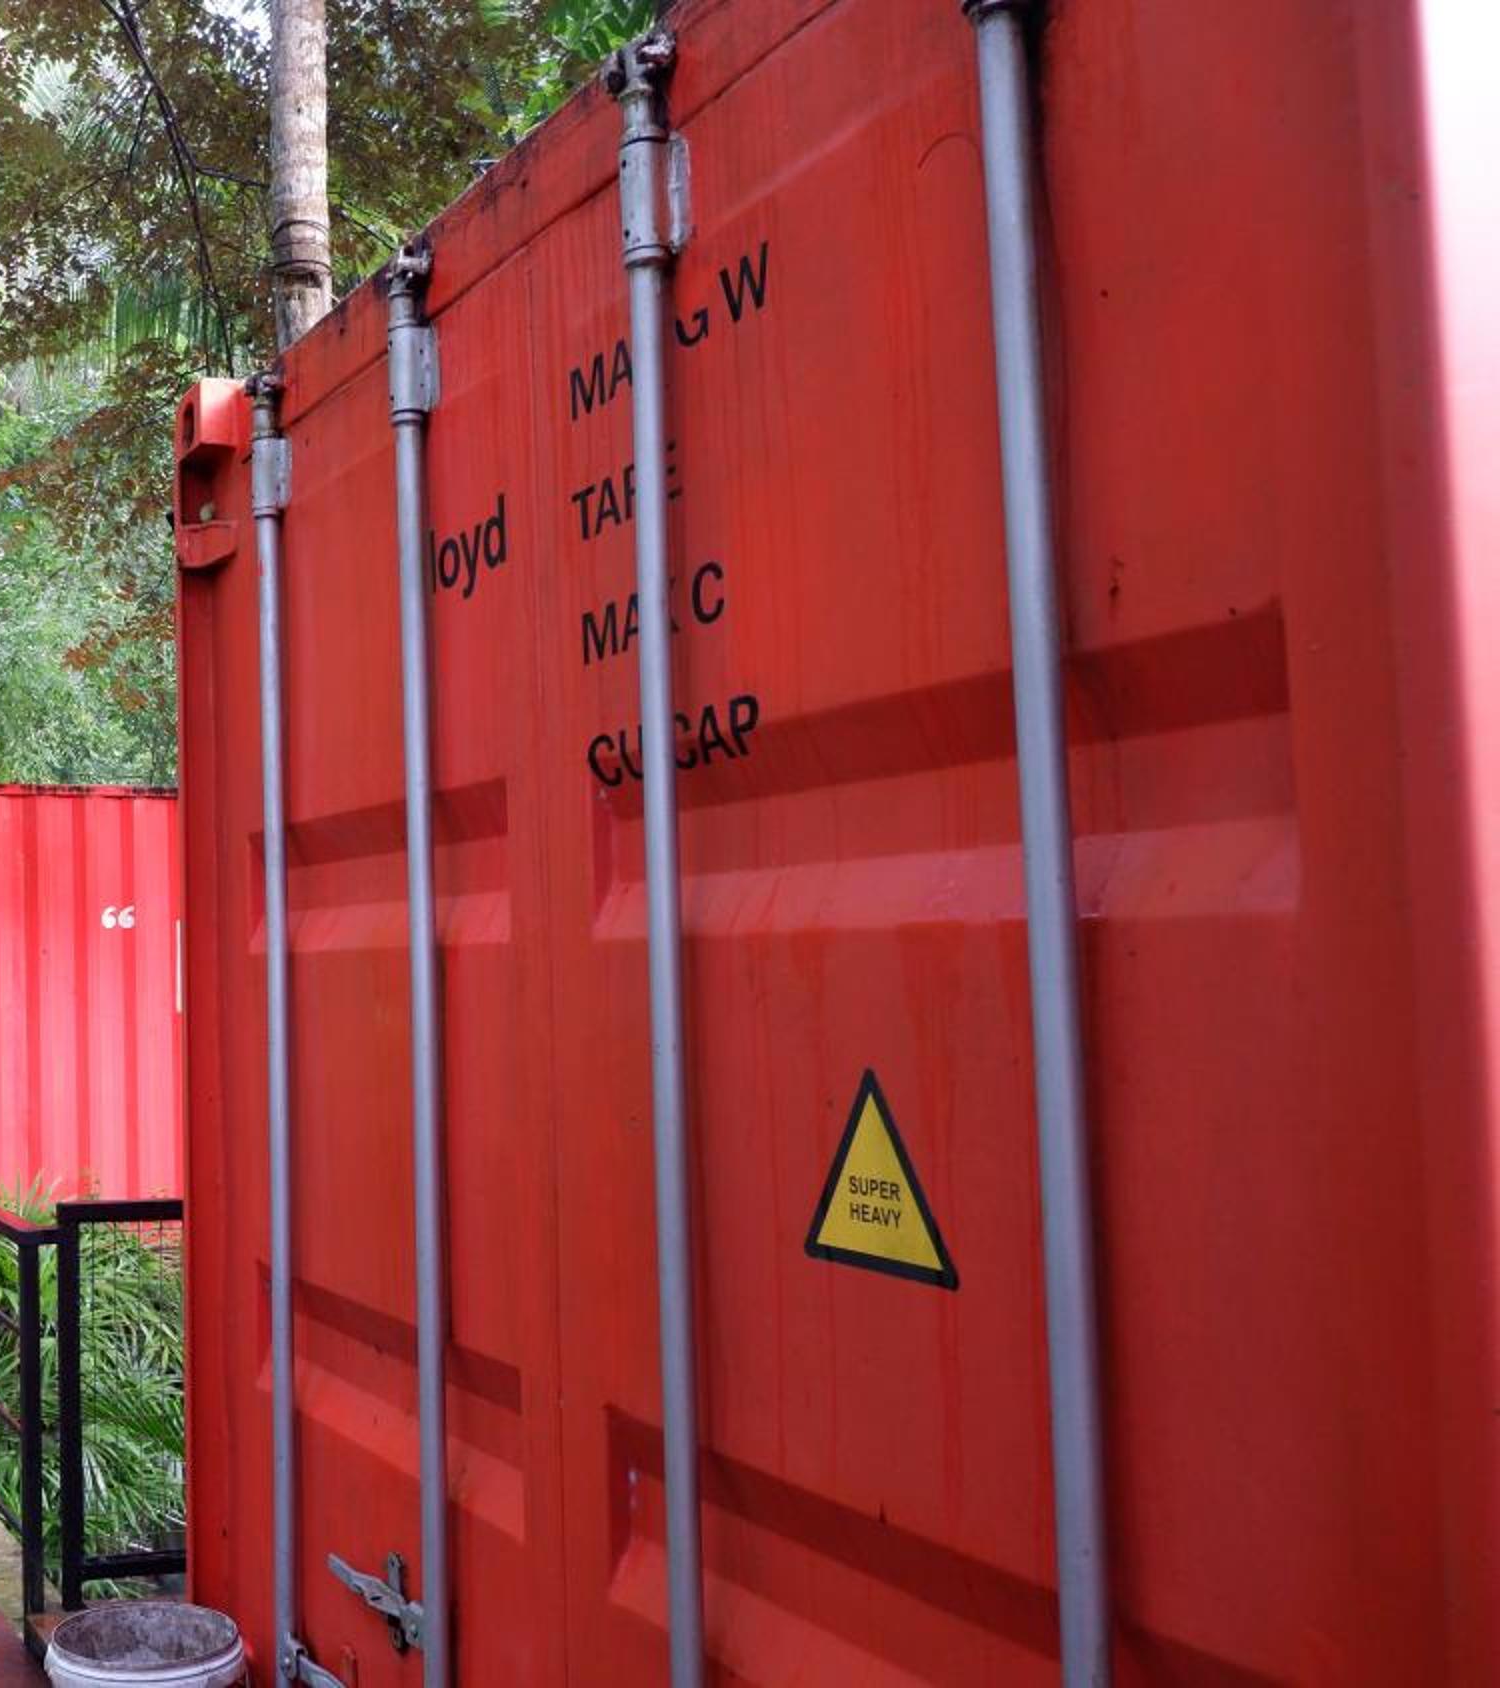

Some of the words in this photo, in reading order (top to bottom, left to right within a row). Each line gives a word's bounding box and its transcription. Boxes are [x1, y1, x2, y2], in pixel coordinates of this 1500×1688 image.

[582, 577, 680, 666] MA
[849, 1175, 901, 1202] SUPER
[849, 1202, 902, 1229] HEAVY
